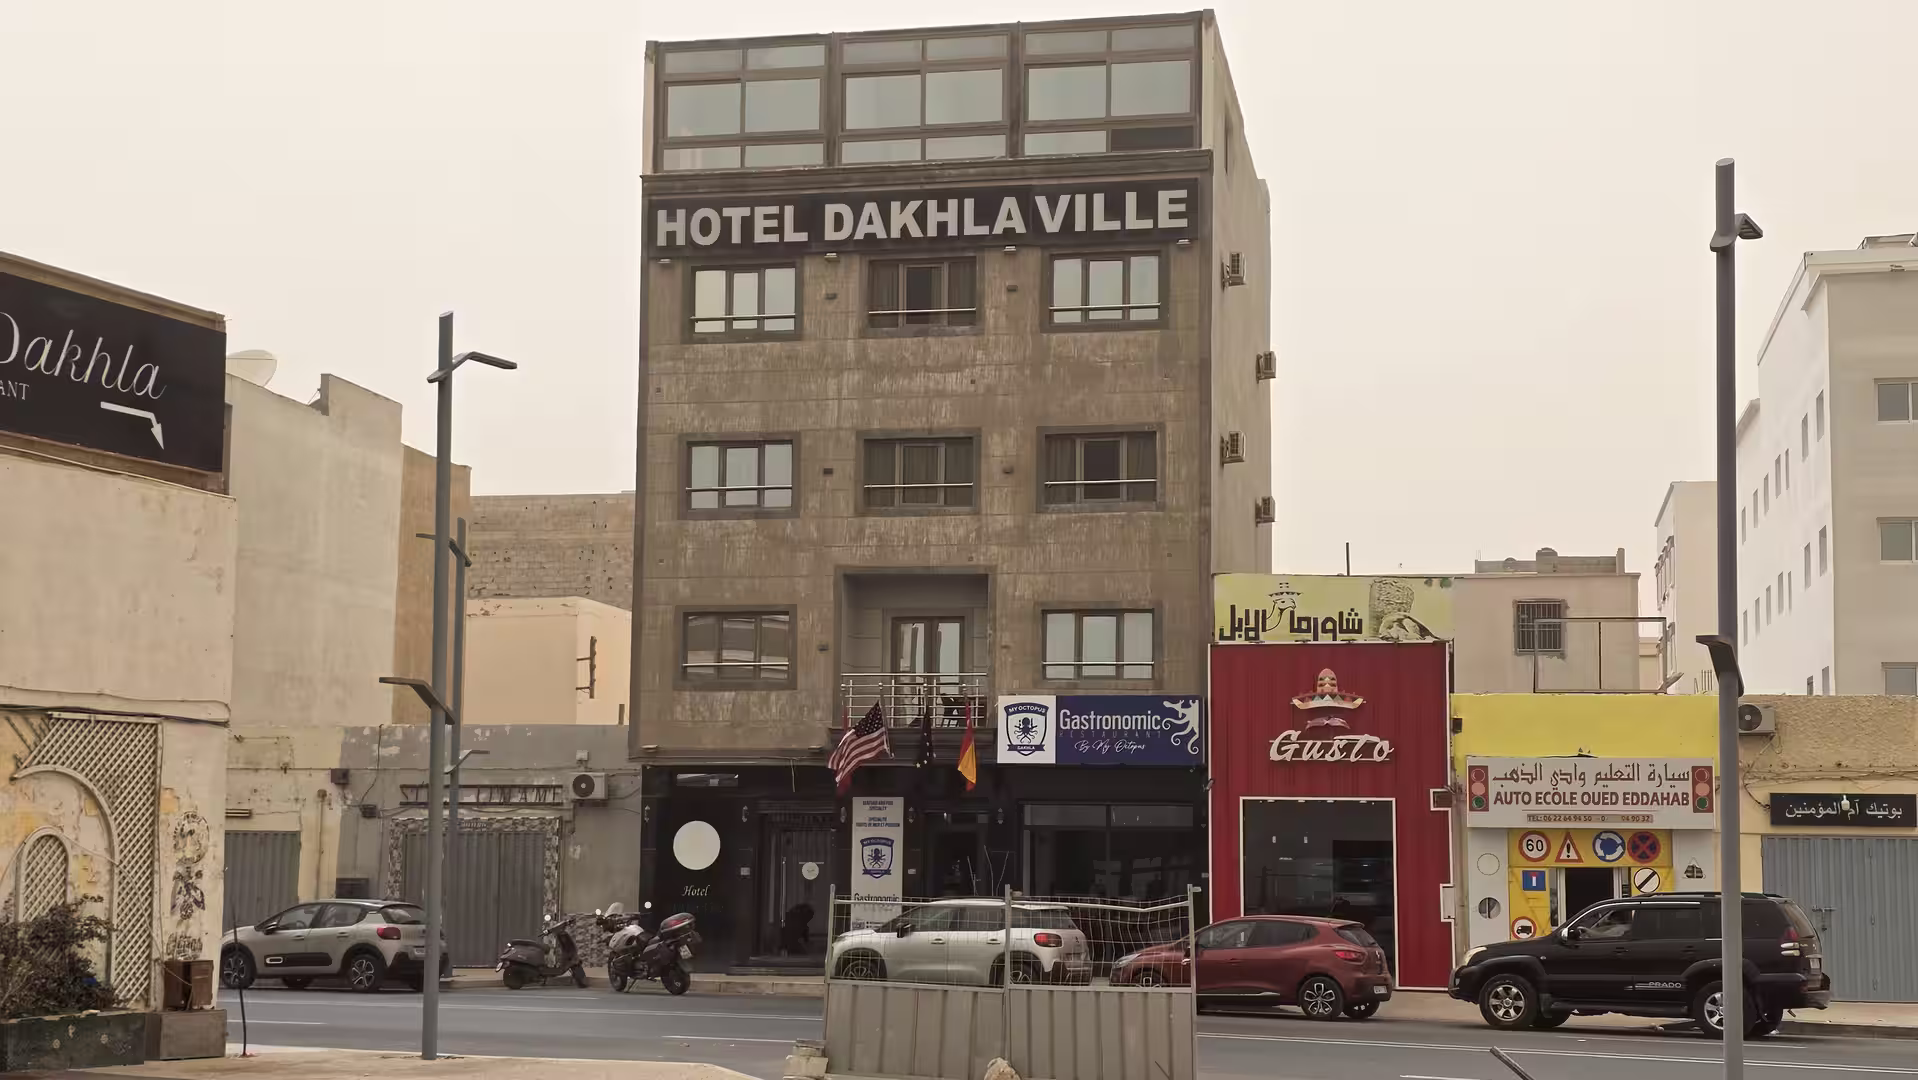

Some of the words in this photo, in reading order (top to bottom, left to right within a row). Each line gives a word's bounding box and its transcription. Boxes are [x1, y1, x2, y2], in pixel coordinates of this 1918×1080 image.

[656, 204, 808, 246] HOTEL
[823, 195, 1027, 241] DAKHLA
[1034, 188, 1188, 234] VILLE
[1290, 608, 1363, 642] شاورما
[1018, 705, 1046, 713] OCTOPUS
[1059, 709, 1161, 730] Gastronomic
[1059, 730, 1161, 738] RESTAURANT
[1074, 739, 1090, 753] By
[1092, 739, 1110, 754] My
[1114, 739, 1146, 754] Octopus
[1492, 762, 1543, 788] الذهب
[1550, 762, 1586, 791] وادي
[1593, 762, 1640, 788] التعليم
[1647, 763, 1690, 788] سيارة
[1493, 791, 1532, 806] AUTO
[1580, 791, 1619, 806] OUED
[1622, 791, 1690, 806] EDDAHAB
[1785, 801, 1841, 818] المؤمنين
[1866, 802, 1903, 819] بوتيك
[1526, 838, 1544, 852] 60
[682, 885, 711, 897] Hotel
[1648, 981, 1682, 989] PRADO
